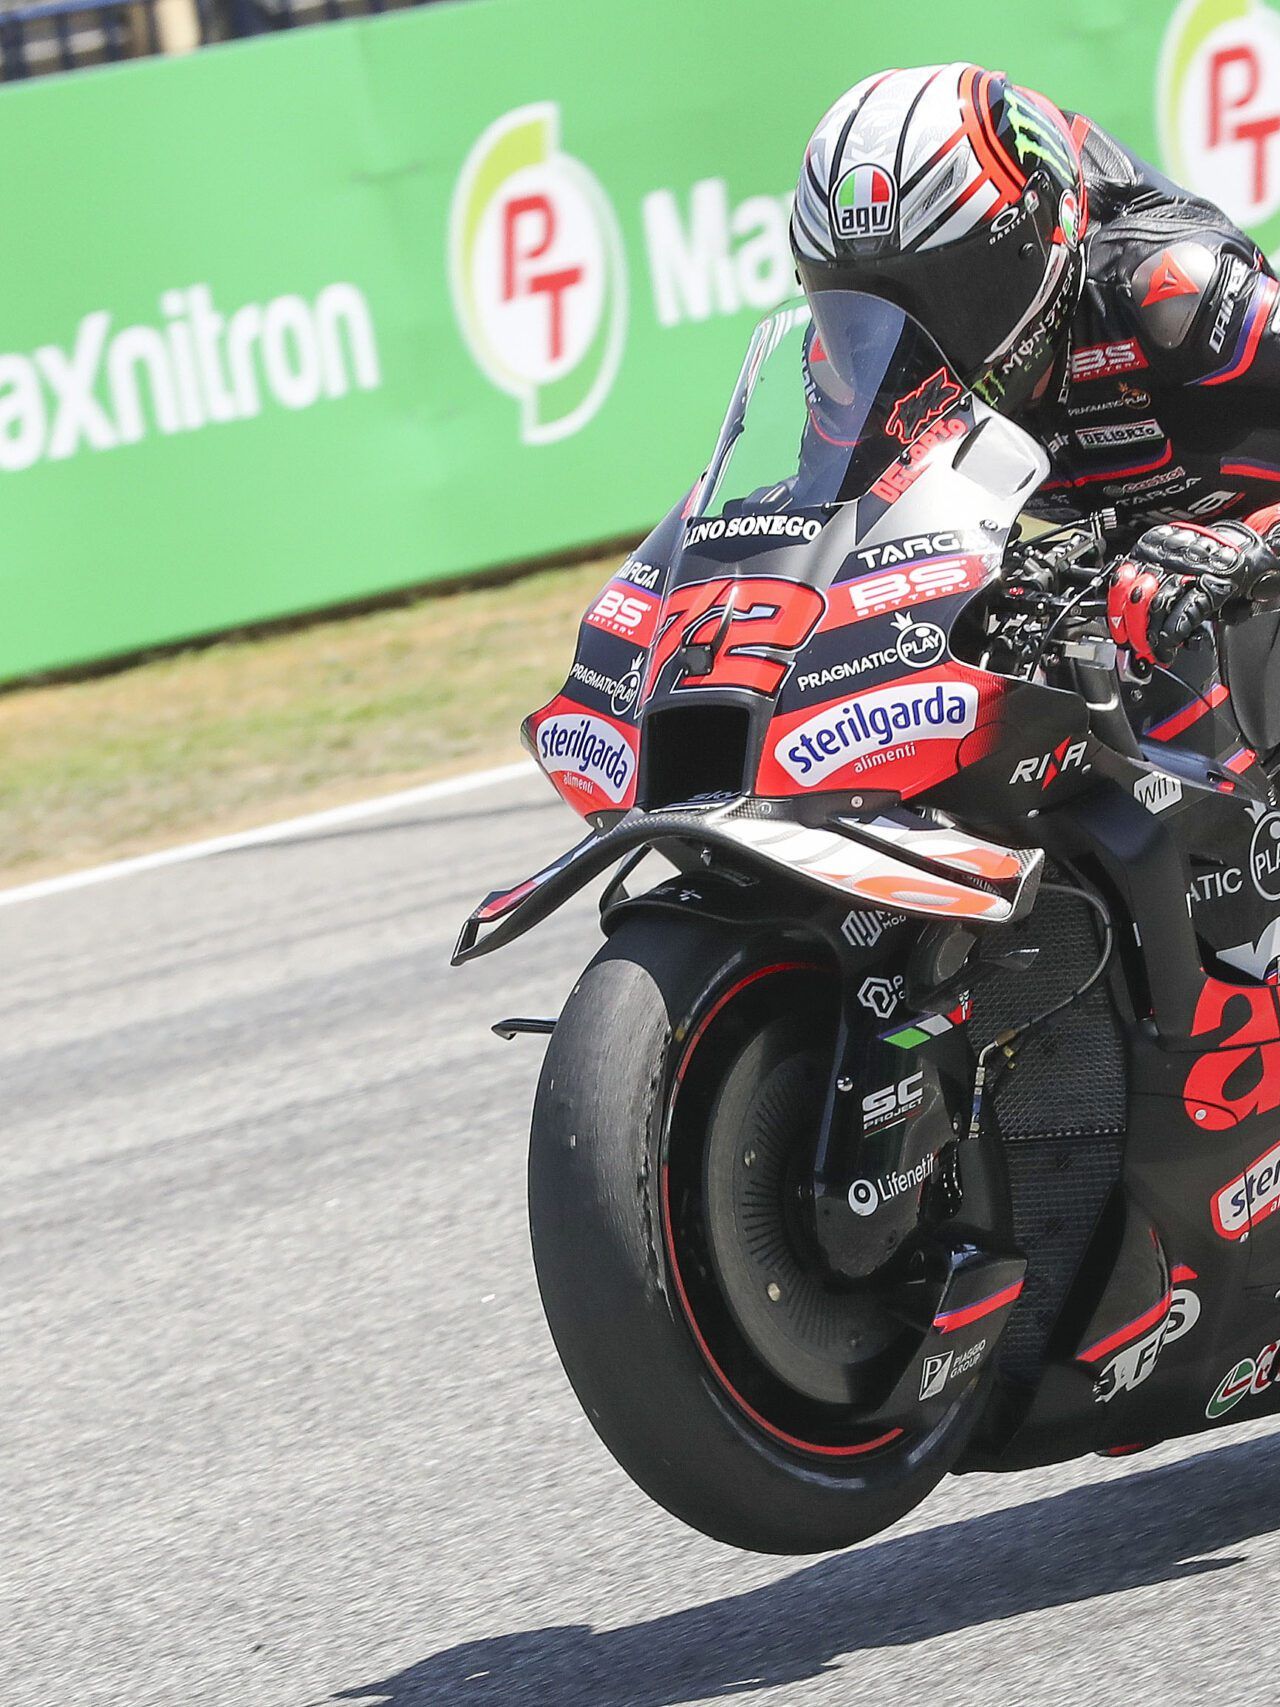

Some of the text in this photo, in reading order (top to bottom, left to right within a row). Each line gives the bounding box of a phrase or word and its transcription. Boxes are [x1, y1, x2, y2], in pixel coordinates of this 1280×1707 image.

[841, 204, 888, 234] agv
[0, 282, 381, 470] axnitron
[1072, 343, 1136, 373] BS
[682, 515, 823, 550] LINO SONEGO
[858, 532, 967, 569] TARG
[849, 558, 968, 610] BS
[593, 589, 644, 628] BS
[645, 574, 829, 701] 72
[797, 632, 942, 692] PRAGMATIC PLAY
[570, 662, 637, 703] PRAGMATIC PLAY
[788, 686, 967, 775] sterilgarda
[541, 719, 628, 789] sterilgarda
[854, 742, 917, 774] alimenti
[562, 772, 594, 795] alimenti
[862, 1070, 924, 1123] SC
[864, 1096, 924, 1130] PROJECT
[951, 1353, 981, 1379] GROUP
